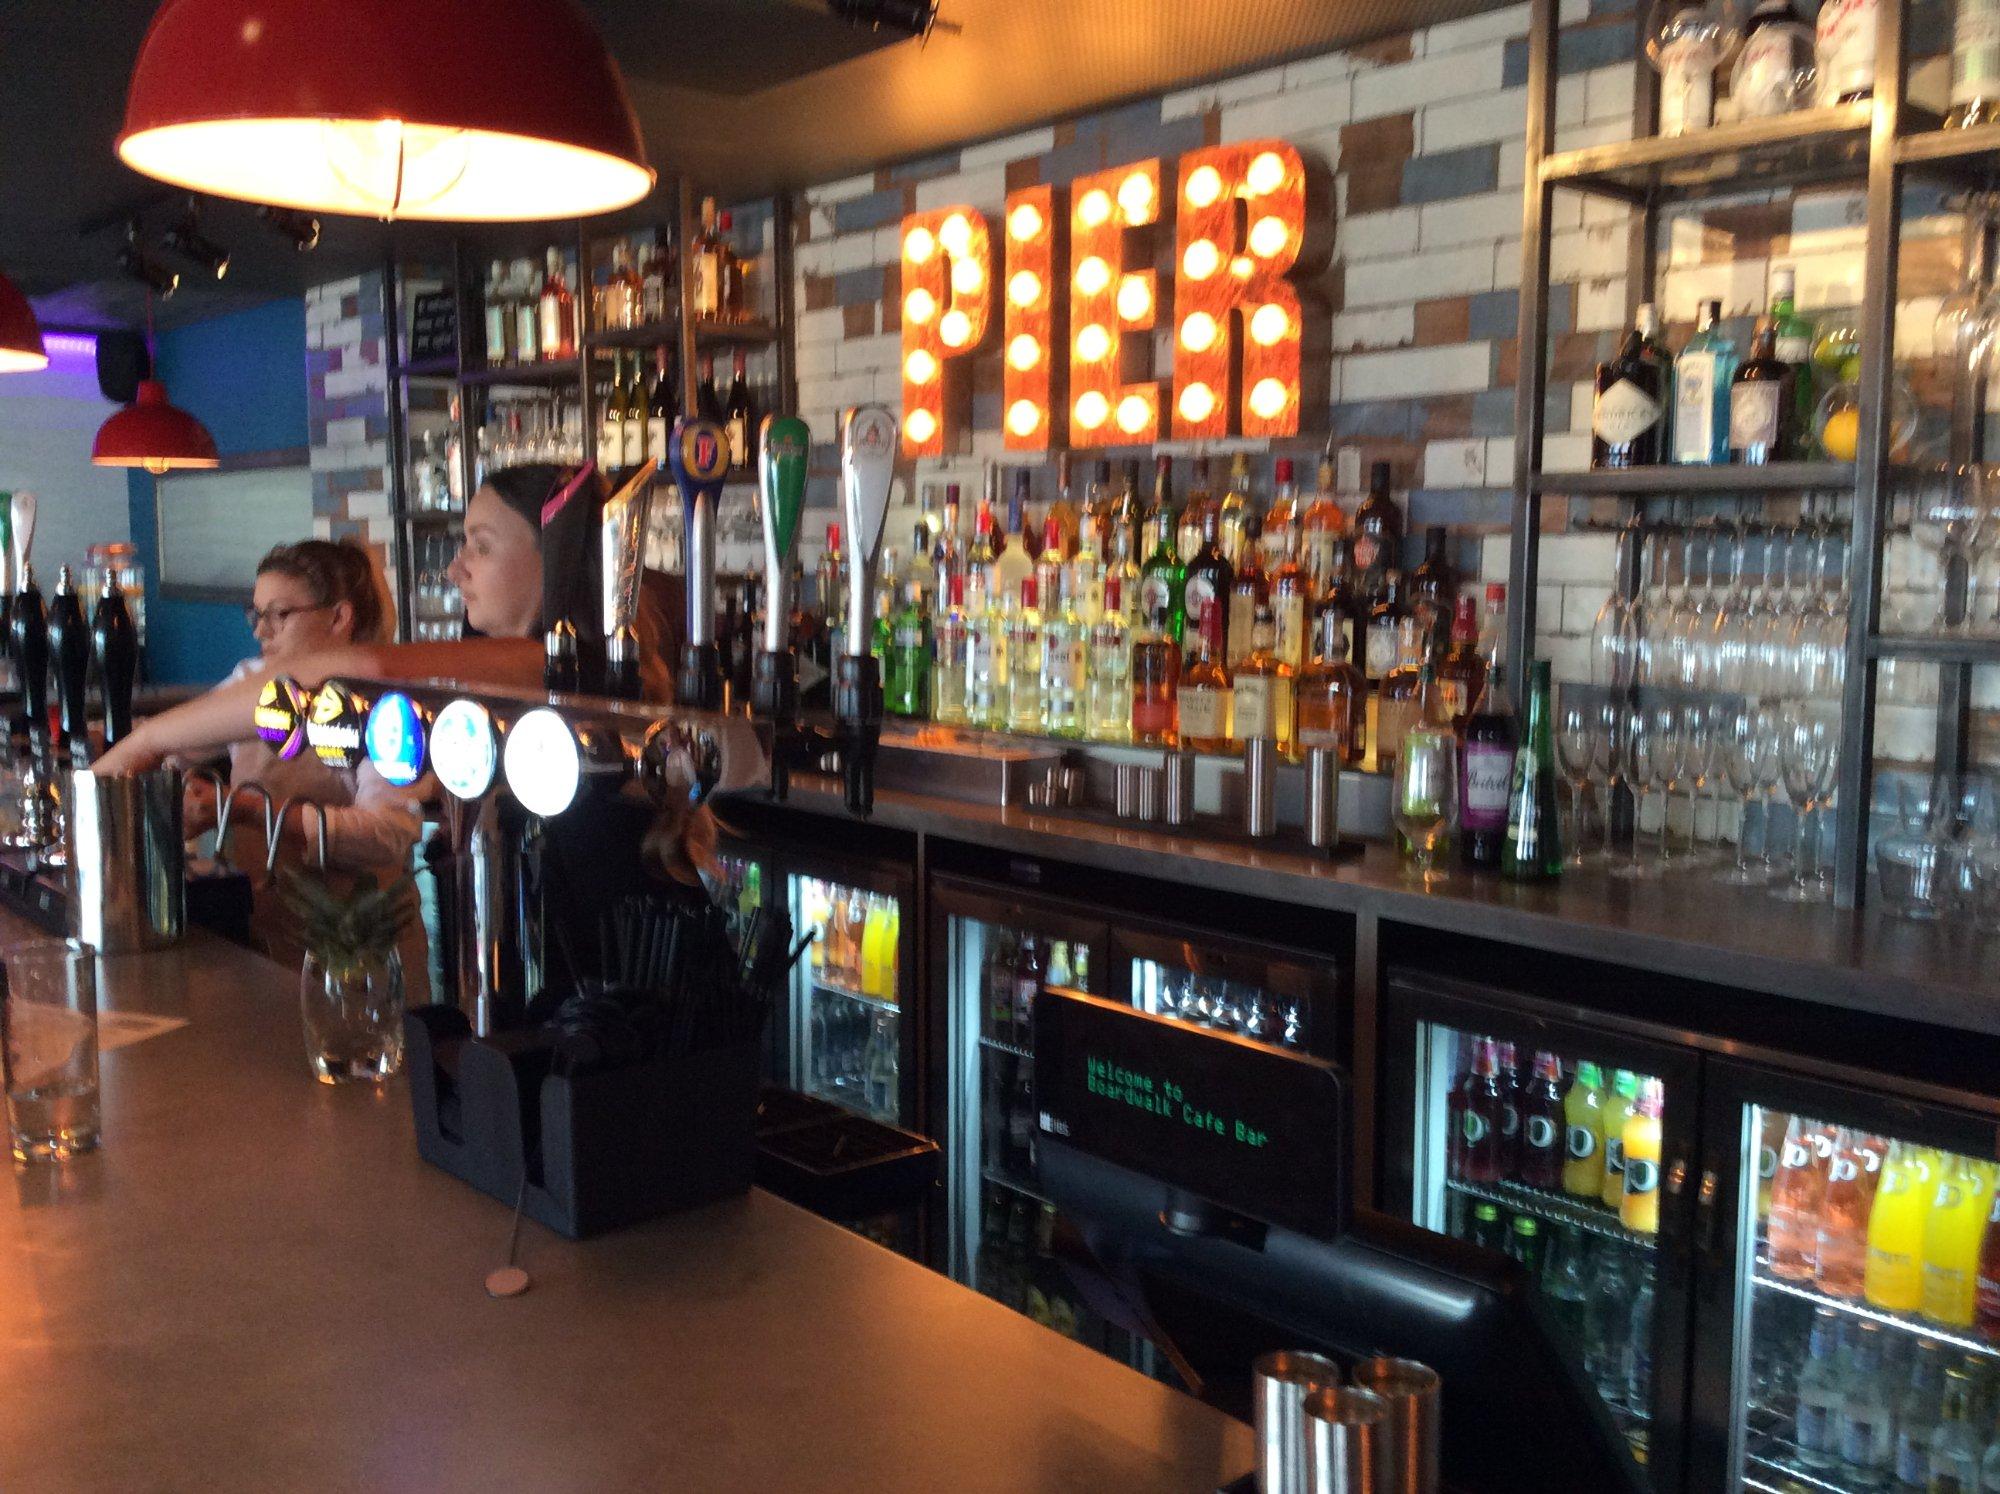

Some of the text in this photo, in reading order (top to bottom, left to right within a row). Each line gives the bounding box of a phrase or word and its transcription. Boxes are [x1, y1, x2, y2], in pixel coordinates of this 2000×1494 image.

[902, 138, 1305, 457] PIER
[1088, 1057, 1184, 1102] Welcome to
[1088, 1076, 1269, 1148] Boardwalk Cafe Bar
